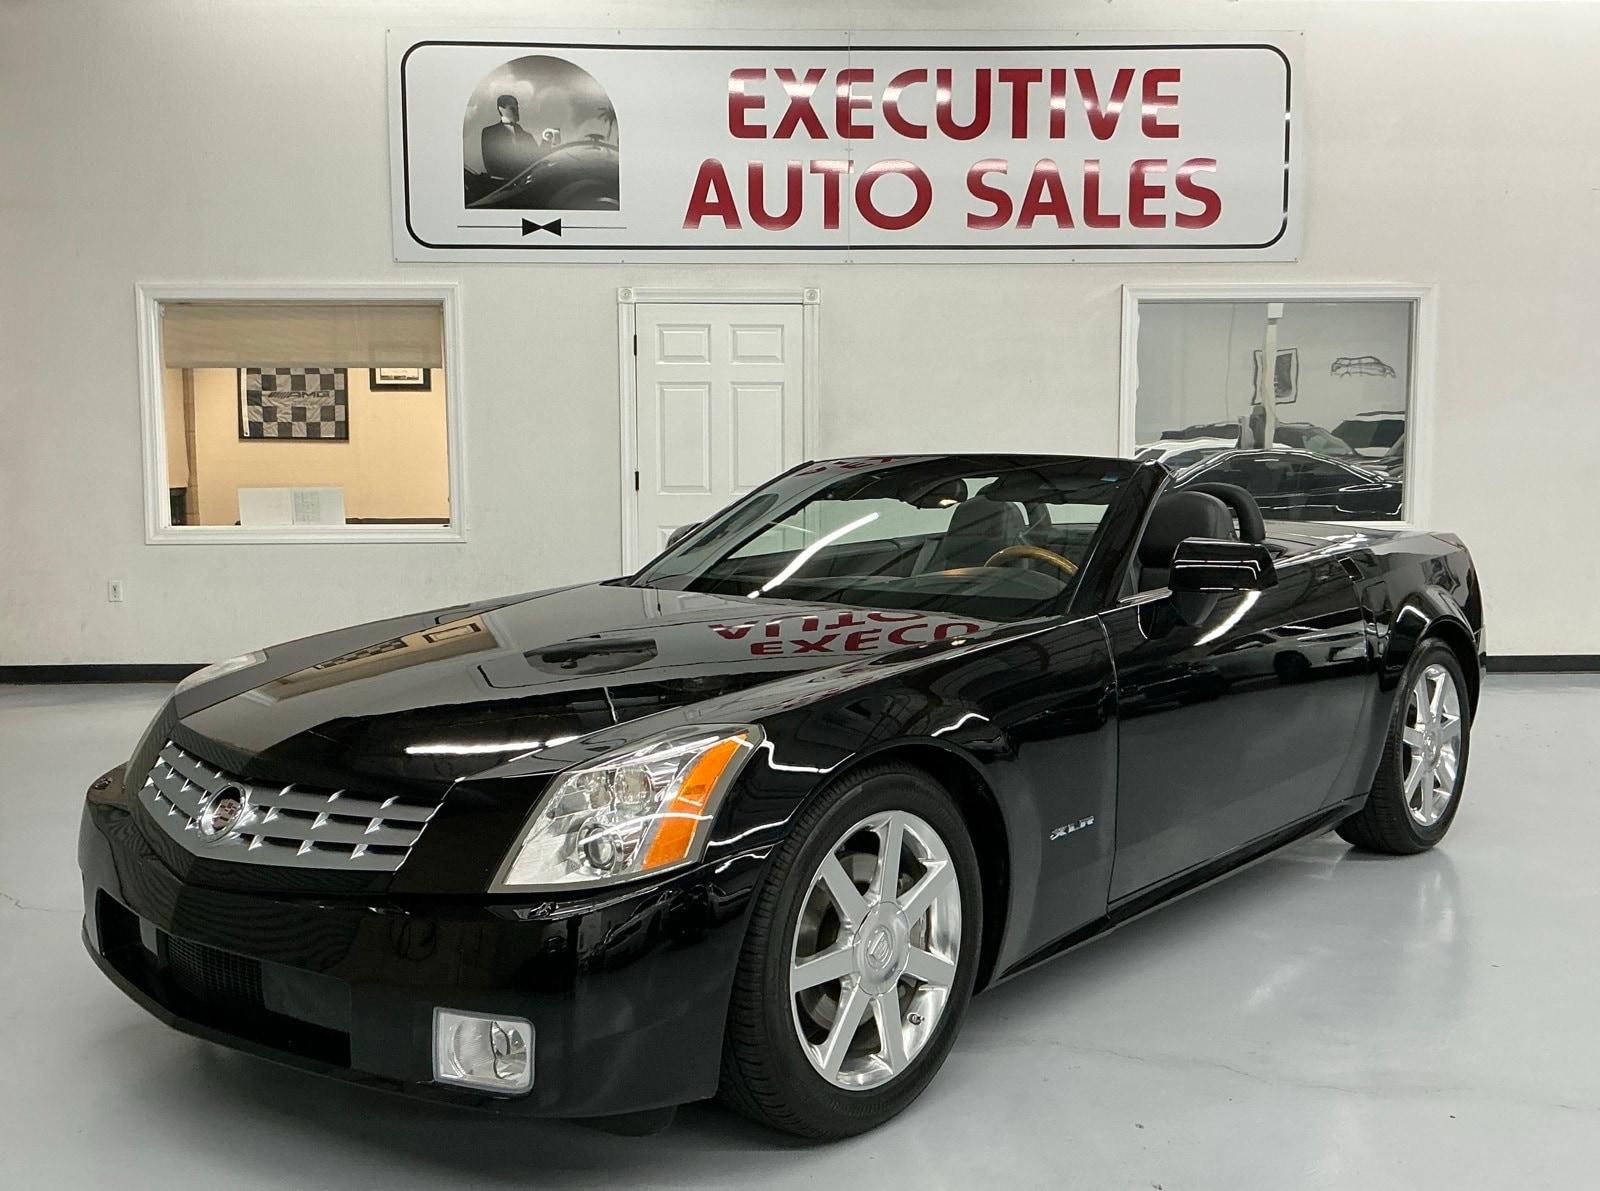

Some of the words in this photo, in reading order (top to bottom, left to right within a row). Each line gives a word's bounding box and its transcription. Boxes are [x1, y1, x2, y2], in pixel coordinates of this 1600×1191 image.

[728, 68, 1182, 140] EXECUTIVE
[682, 158, 933, 230] AUTO
[966, 158, 1222, 230] SALES
